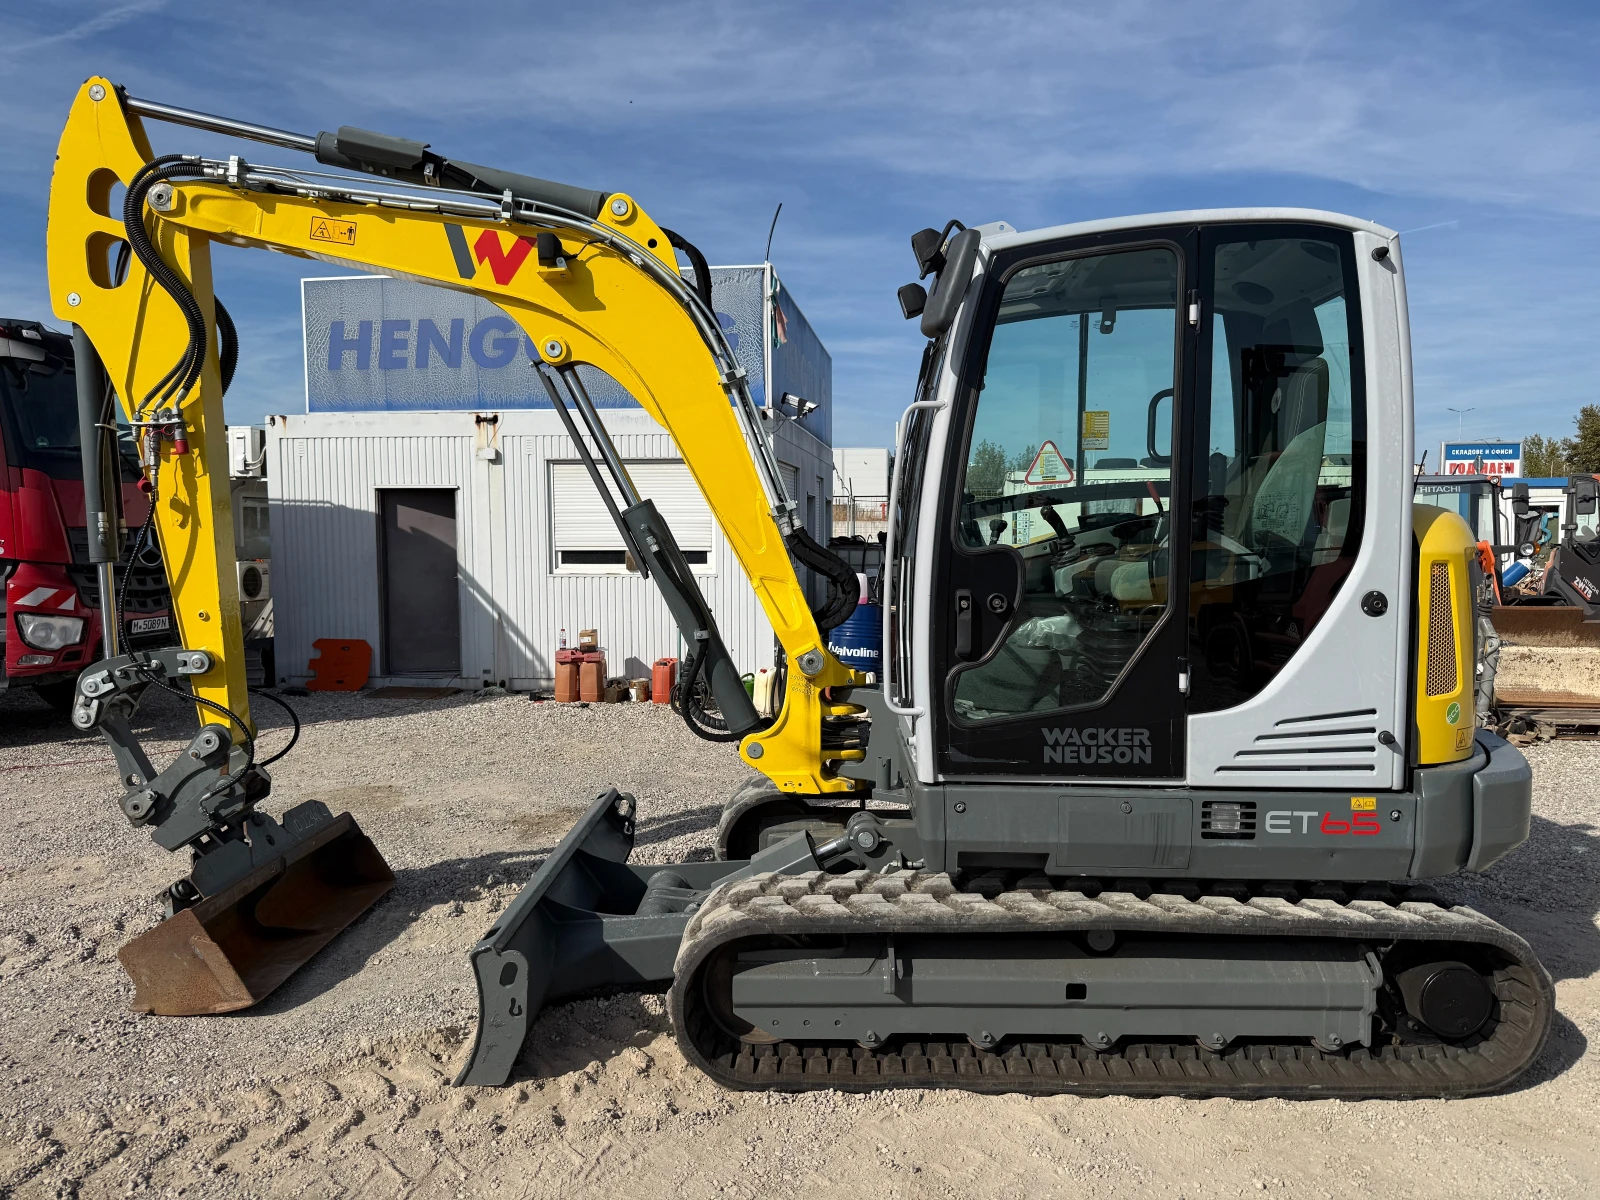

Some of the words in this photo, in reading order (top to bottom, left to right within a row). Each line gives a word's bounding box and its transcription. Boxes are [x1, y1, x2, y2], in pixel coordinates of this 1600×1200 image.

[1419, 485, 1461, 493] HITACHI
[1573, 575, 1593, 599] ZW75
[1041, 727, 1152, 746] WACKER
[1043, 745, 1152, 764] NEUSON
[1264, 810, 1381, 836] ET65
